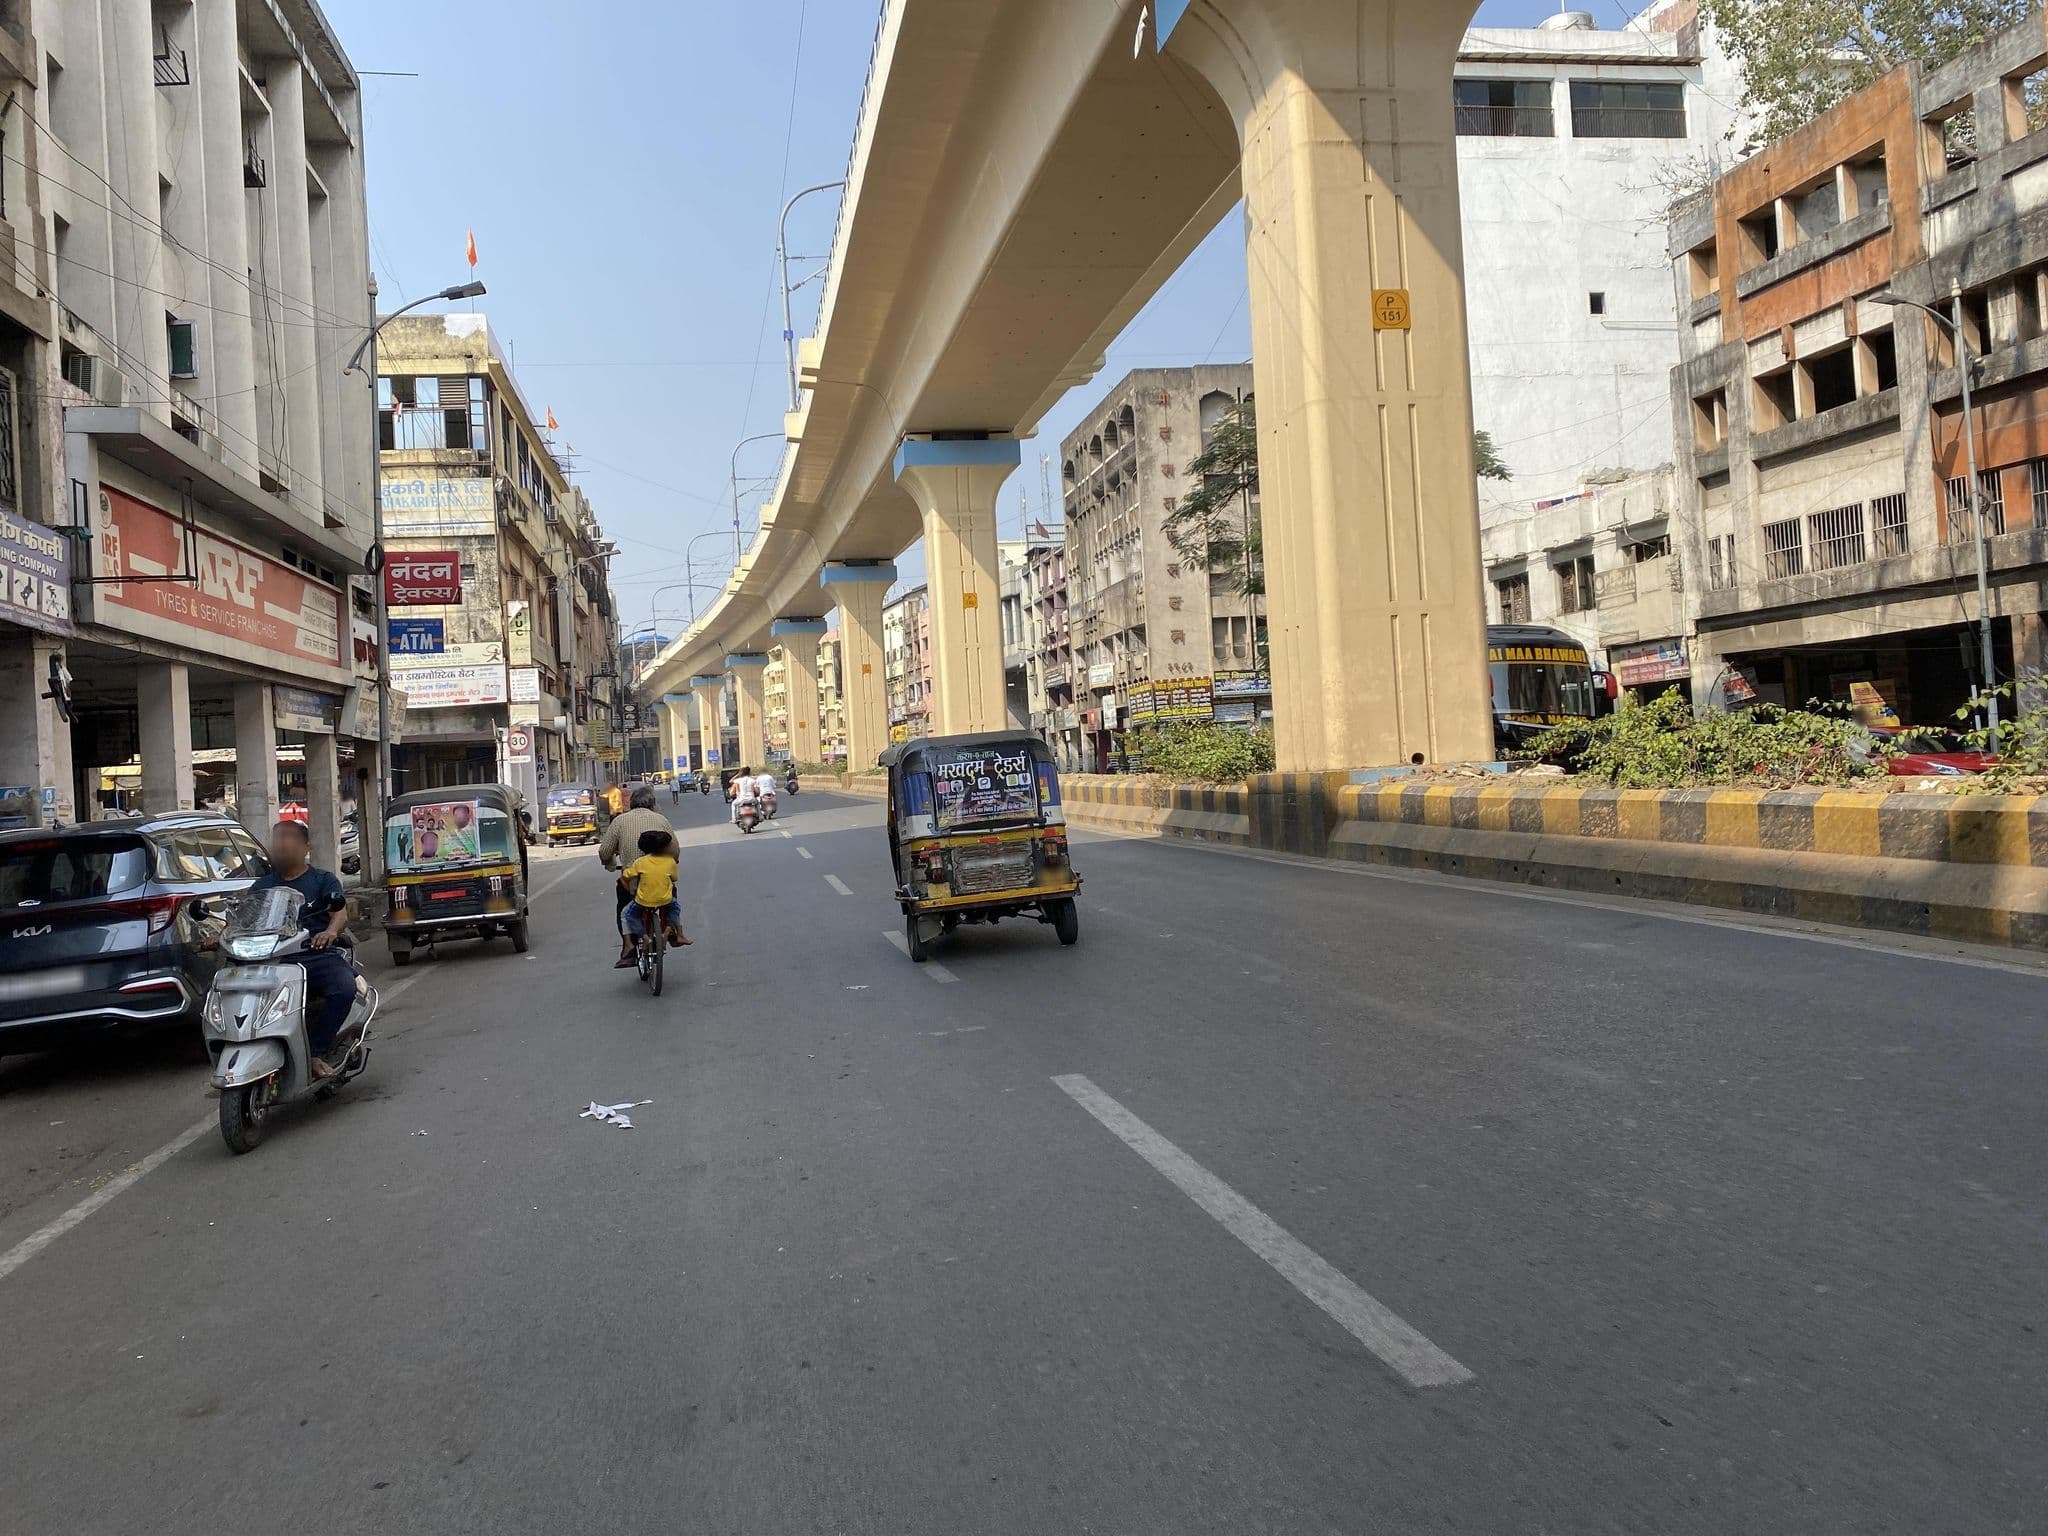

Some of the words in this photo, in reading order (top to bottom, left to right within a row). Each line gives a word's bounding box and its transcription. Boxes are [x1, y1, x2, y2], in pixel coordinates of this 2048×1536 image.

[1386, 296, 1395, 307] P
[1381, 310, 1401, 321] 151
[18, 554, 57, 578] COMPANY
[390, 556, 453, 581] नंदन
[392, 583, 453, 603] ट्रेवल्स
[154, 589, 187, 614] TYRES
[190, 598, 198, 618] &
[200, 603, 236, 629] SERVICE
[237, 615, 279, 640] FRANCHISE
[400, 634, 434, 650] ATM
[1489, 647, 1503, 661] AI
[1505, 647, 1533, 660] MAA
[1534, 647, 1586, 662] BHAWANI
[511, 736, 526, 746] 30
[937, 760, 985, 785] मखदुम
[993, 750, 1026, 780] ट्रेडर्स
